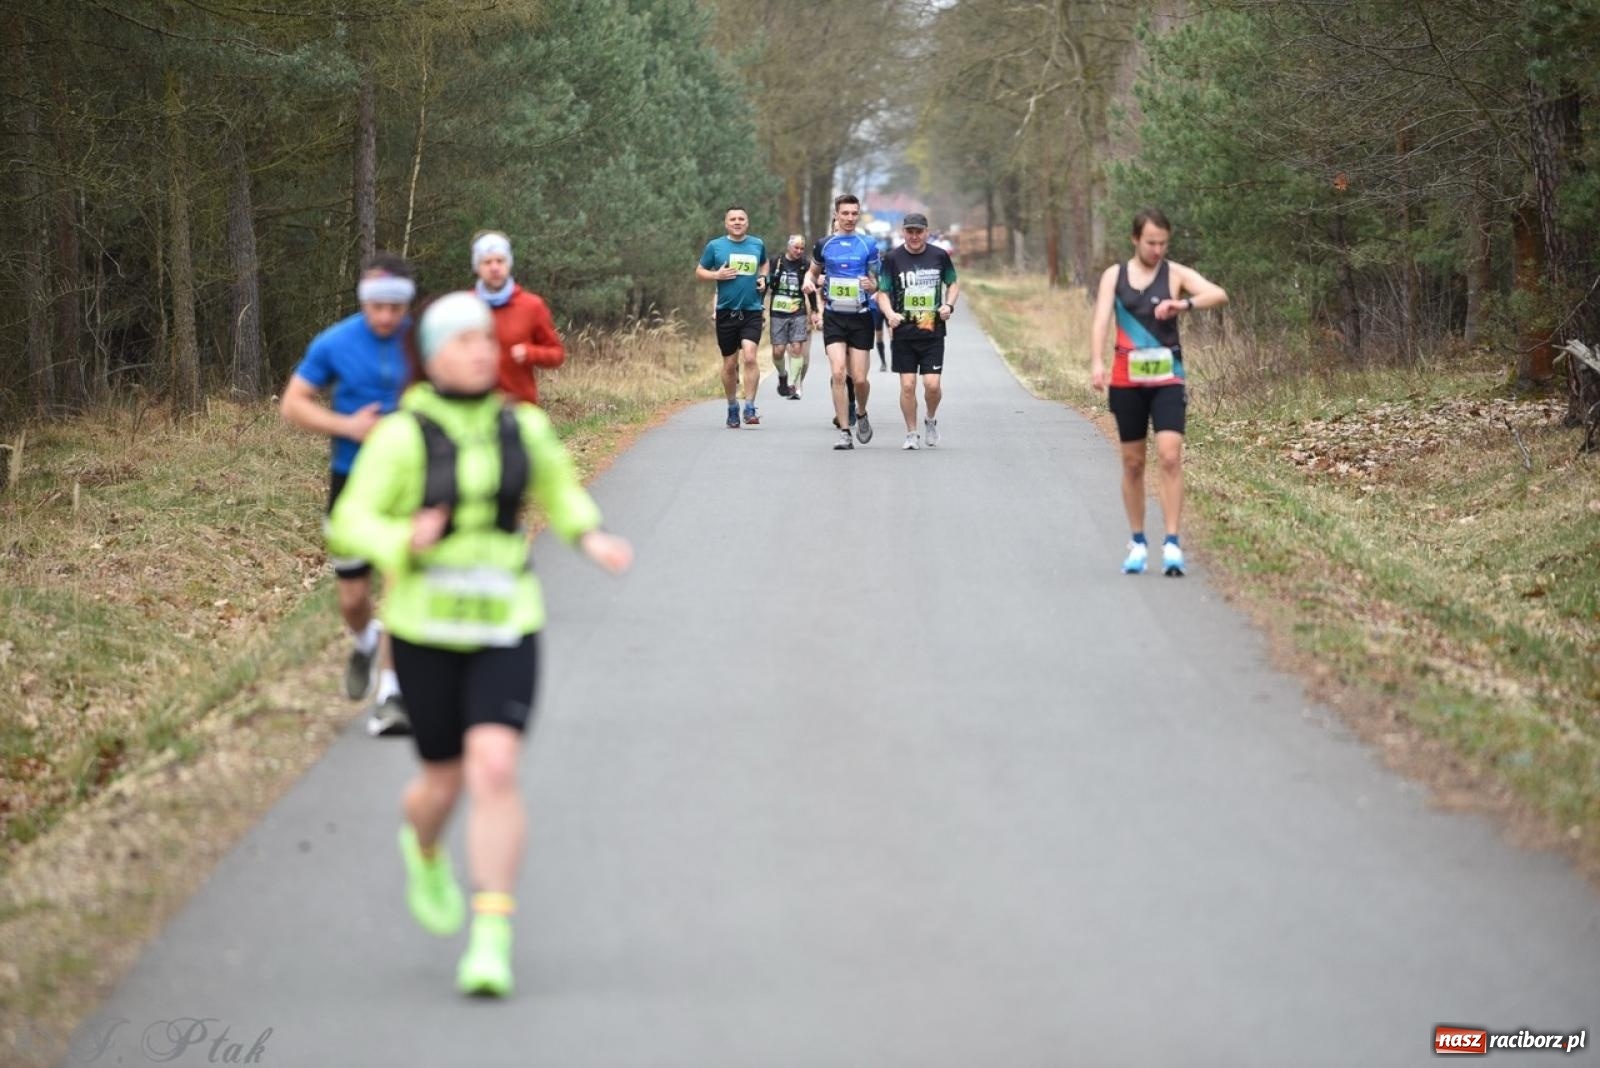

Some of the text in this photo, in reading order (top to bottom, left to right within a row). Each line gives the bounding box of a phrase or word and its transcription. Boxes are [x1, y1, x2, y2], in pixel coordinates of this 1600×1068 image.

[736, 261, 751, 272] 75
[898, 271, 916, 289] 10
[836, 286, 850, 297] 31
[911, 296, 926, 307] 83
[1140, 361, 1160, 374] 47
